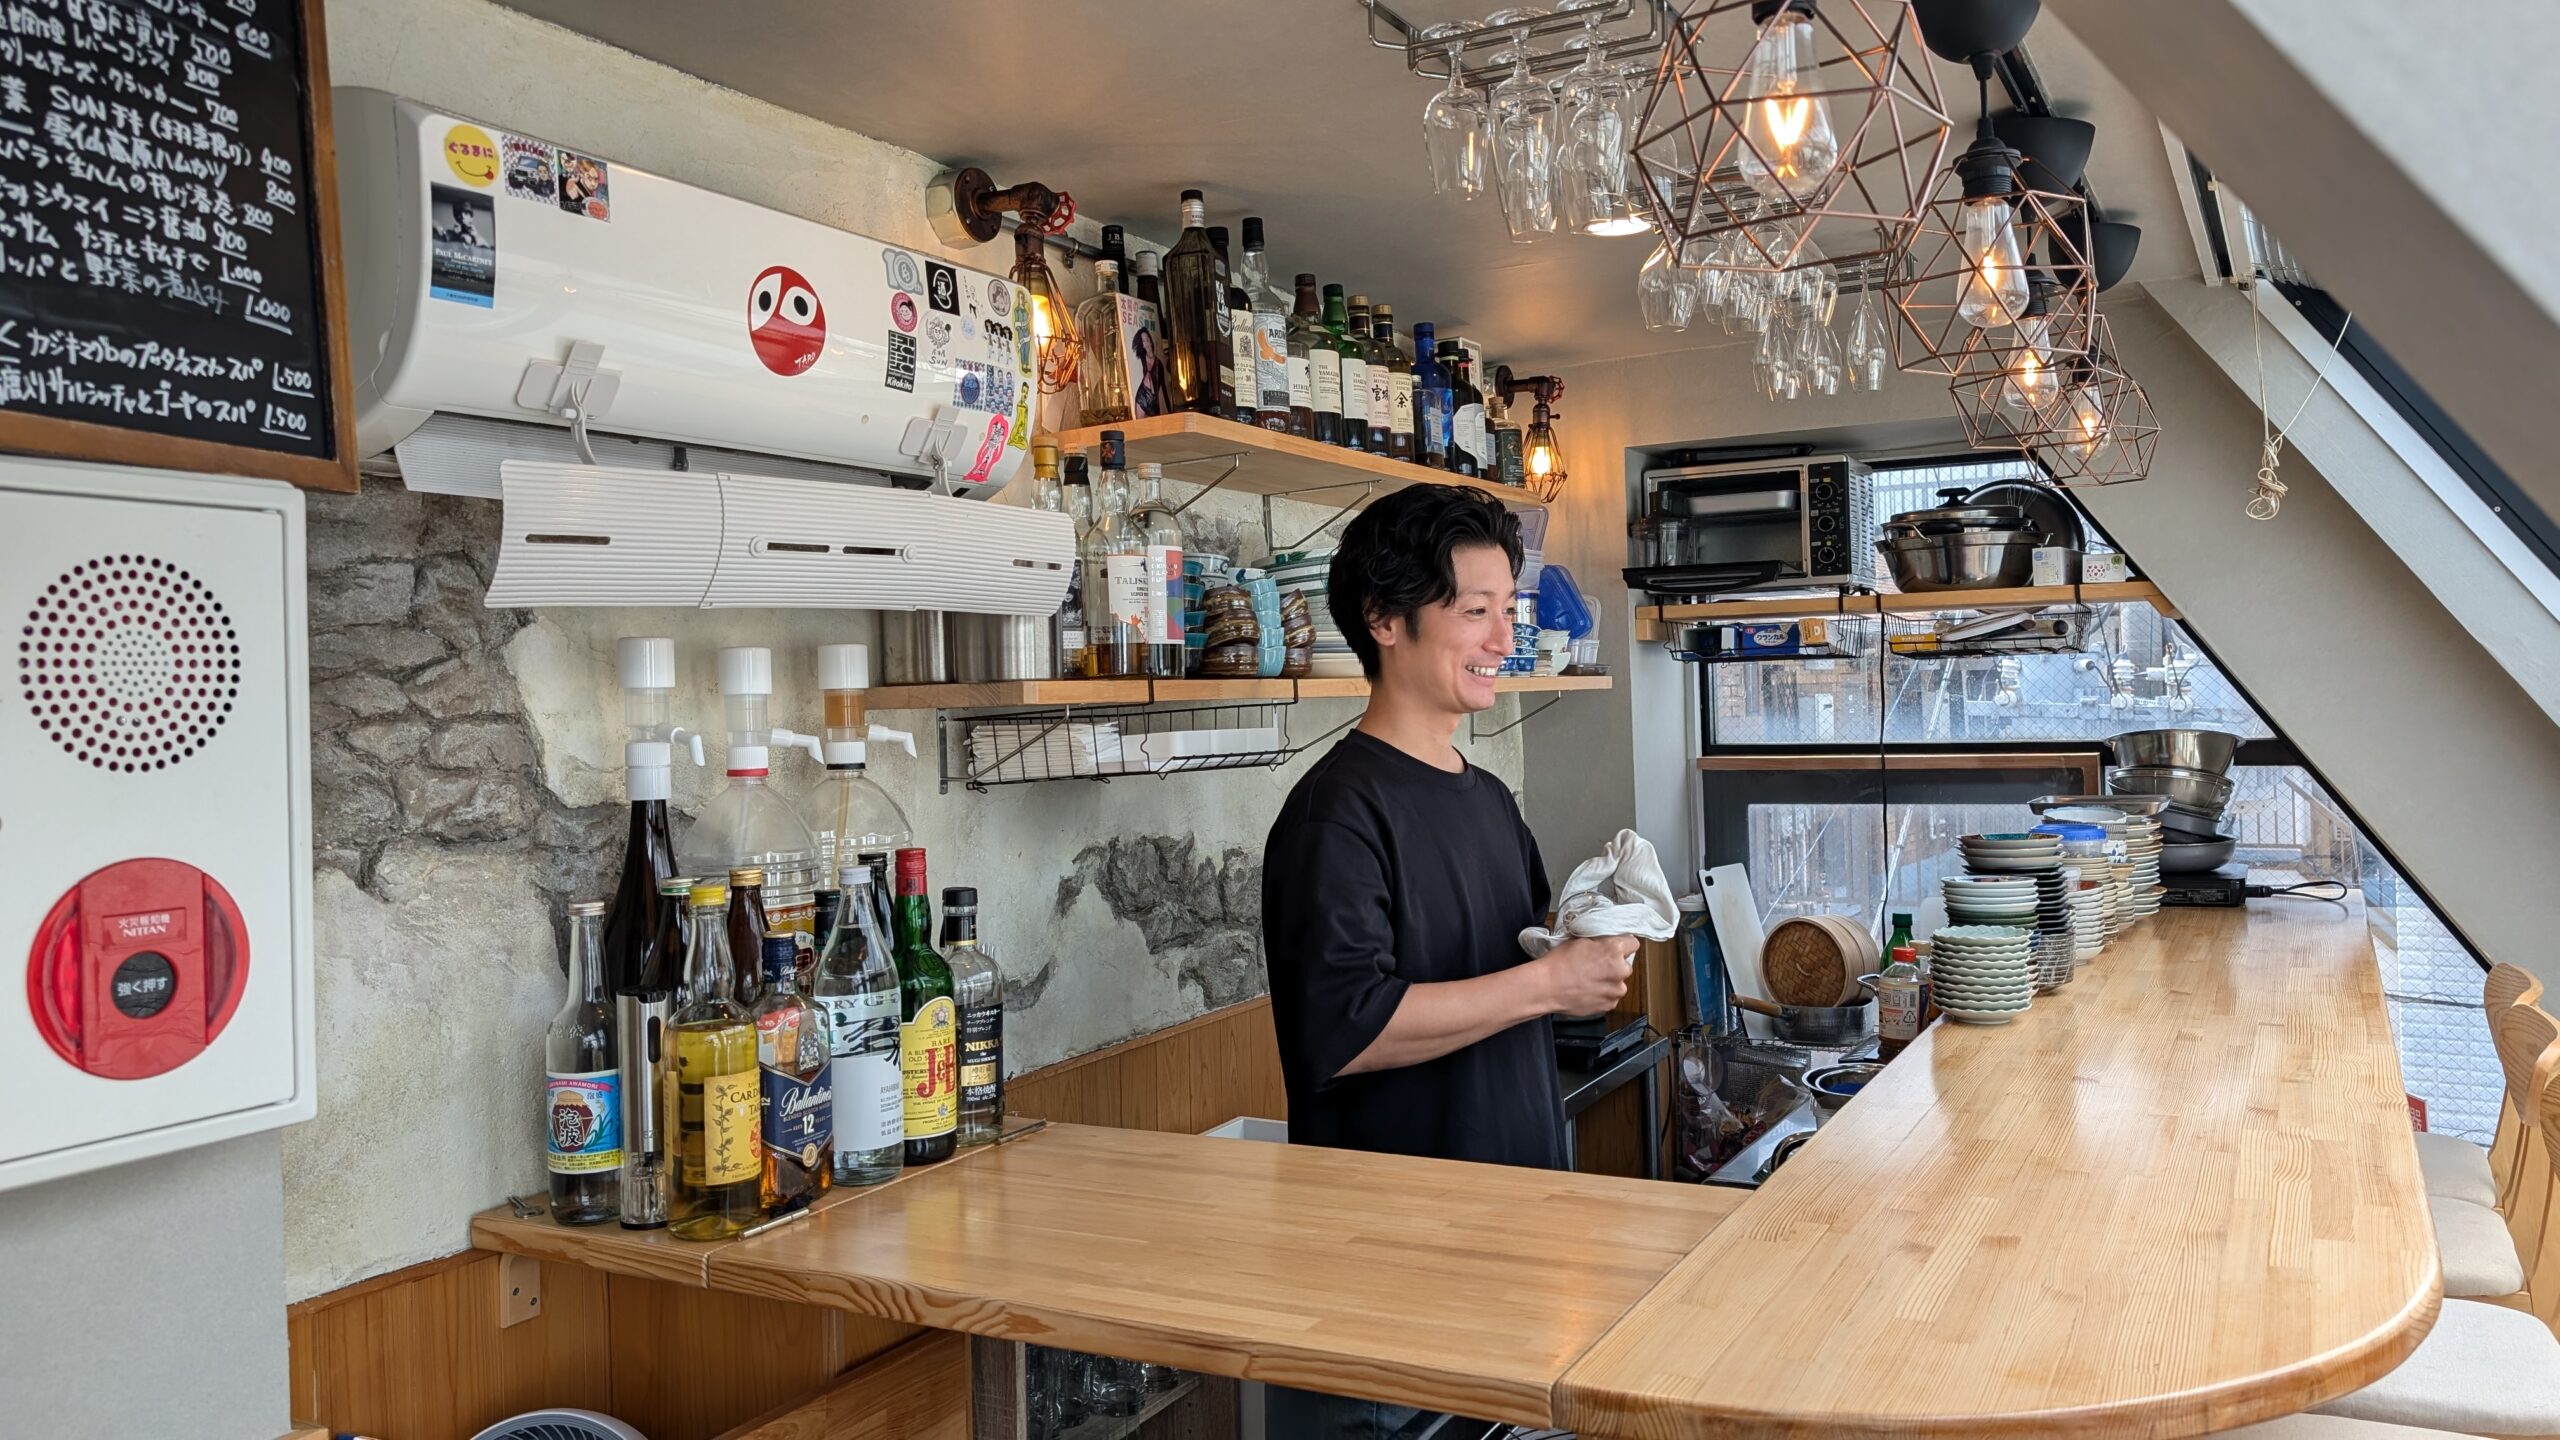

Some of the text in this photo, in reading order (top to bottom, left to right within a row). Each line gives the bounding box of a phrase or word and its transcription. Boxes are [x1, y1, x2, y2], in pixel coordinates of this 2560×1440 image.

[190, 33, 232, 67] 500
[234, 22, 270, 50] 600
[183, 60, 220, 89] 800
[204, 97, 239, 125] 700
[260, 146, 293, 177] 900
[265, 179, 297, 207] 800
[0, 208, 61, 250] ッサム
[242, 202, 274, 228] 800
[212, 221, 248, 254] 900
[794, 353, 817, 369] TARO
[122, 925, 167, 938] NITTAN
[117, 977, 169, 997] 強く押す
[964, 1038, 1000, 1053] NIKKA
[966, 1084, 997, 1097] 本格焼酎
[560, 1108, 581, 1147] 泡波
[802, 1113, 815, 1135] 12
